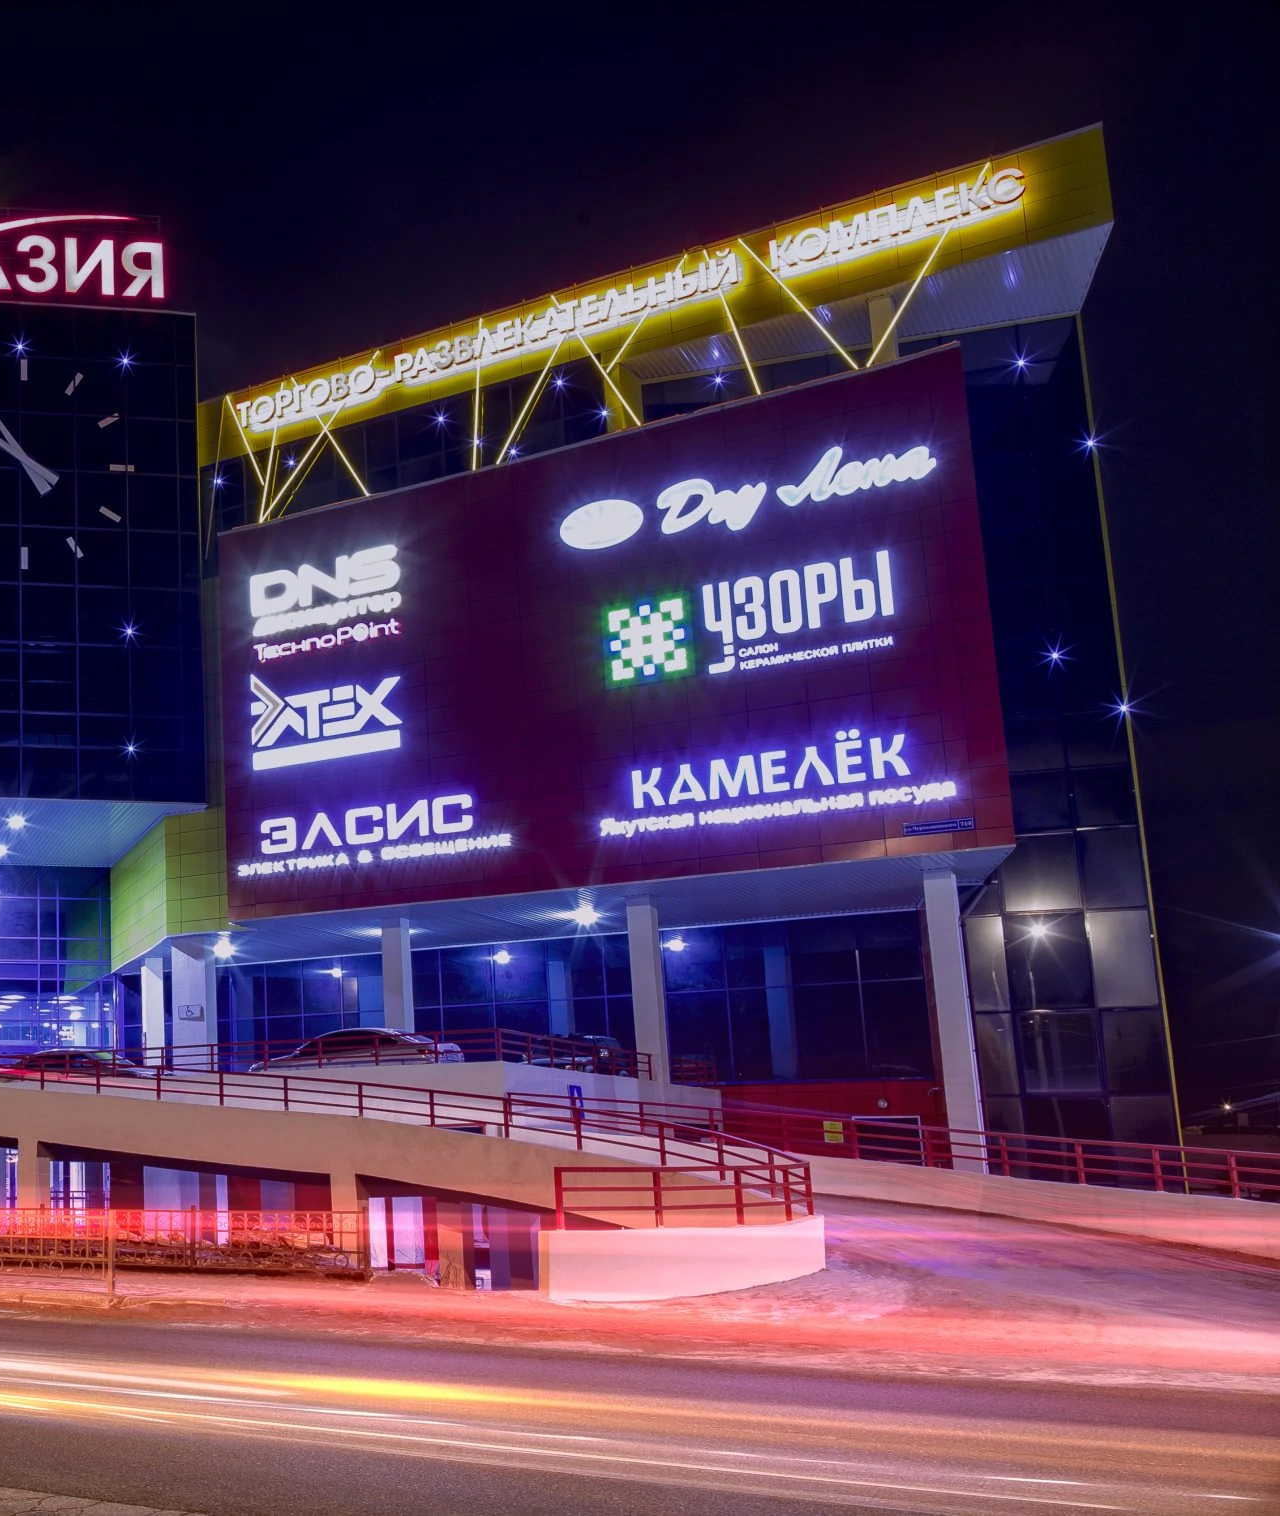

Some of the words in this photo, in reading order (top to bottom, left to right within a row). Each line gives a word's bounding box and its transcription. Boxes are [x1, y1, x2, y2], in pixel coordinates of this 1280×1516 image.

[769, 167, 1026, 273] КОМПЛЕКС
[250, 544, 401, 618] DNS
[702, 550, 895, 675] УЗОРЫ
[738, 642, 779, 658] САЛОН
[739, 645, 839, 671] КЕРАМИЧЕСКОЙ
[841, 635, 894, 654] ПЛИТКИ
[631, 728, 911, 810] КАМЕЛЁК
[238, 852, 350, 877] ЭЛЕКТРИКА
[381, 833, 513, 861] ОСВЕЩЕНИЕ
[261, 794, 474, 855] ЭЛСИС
